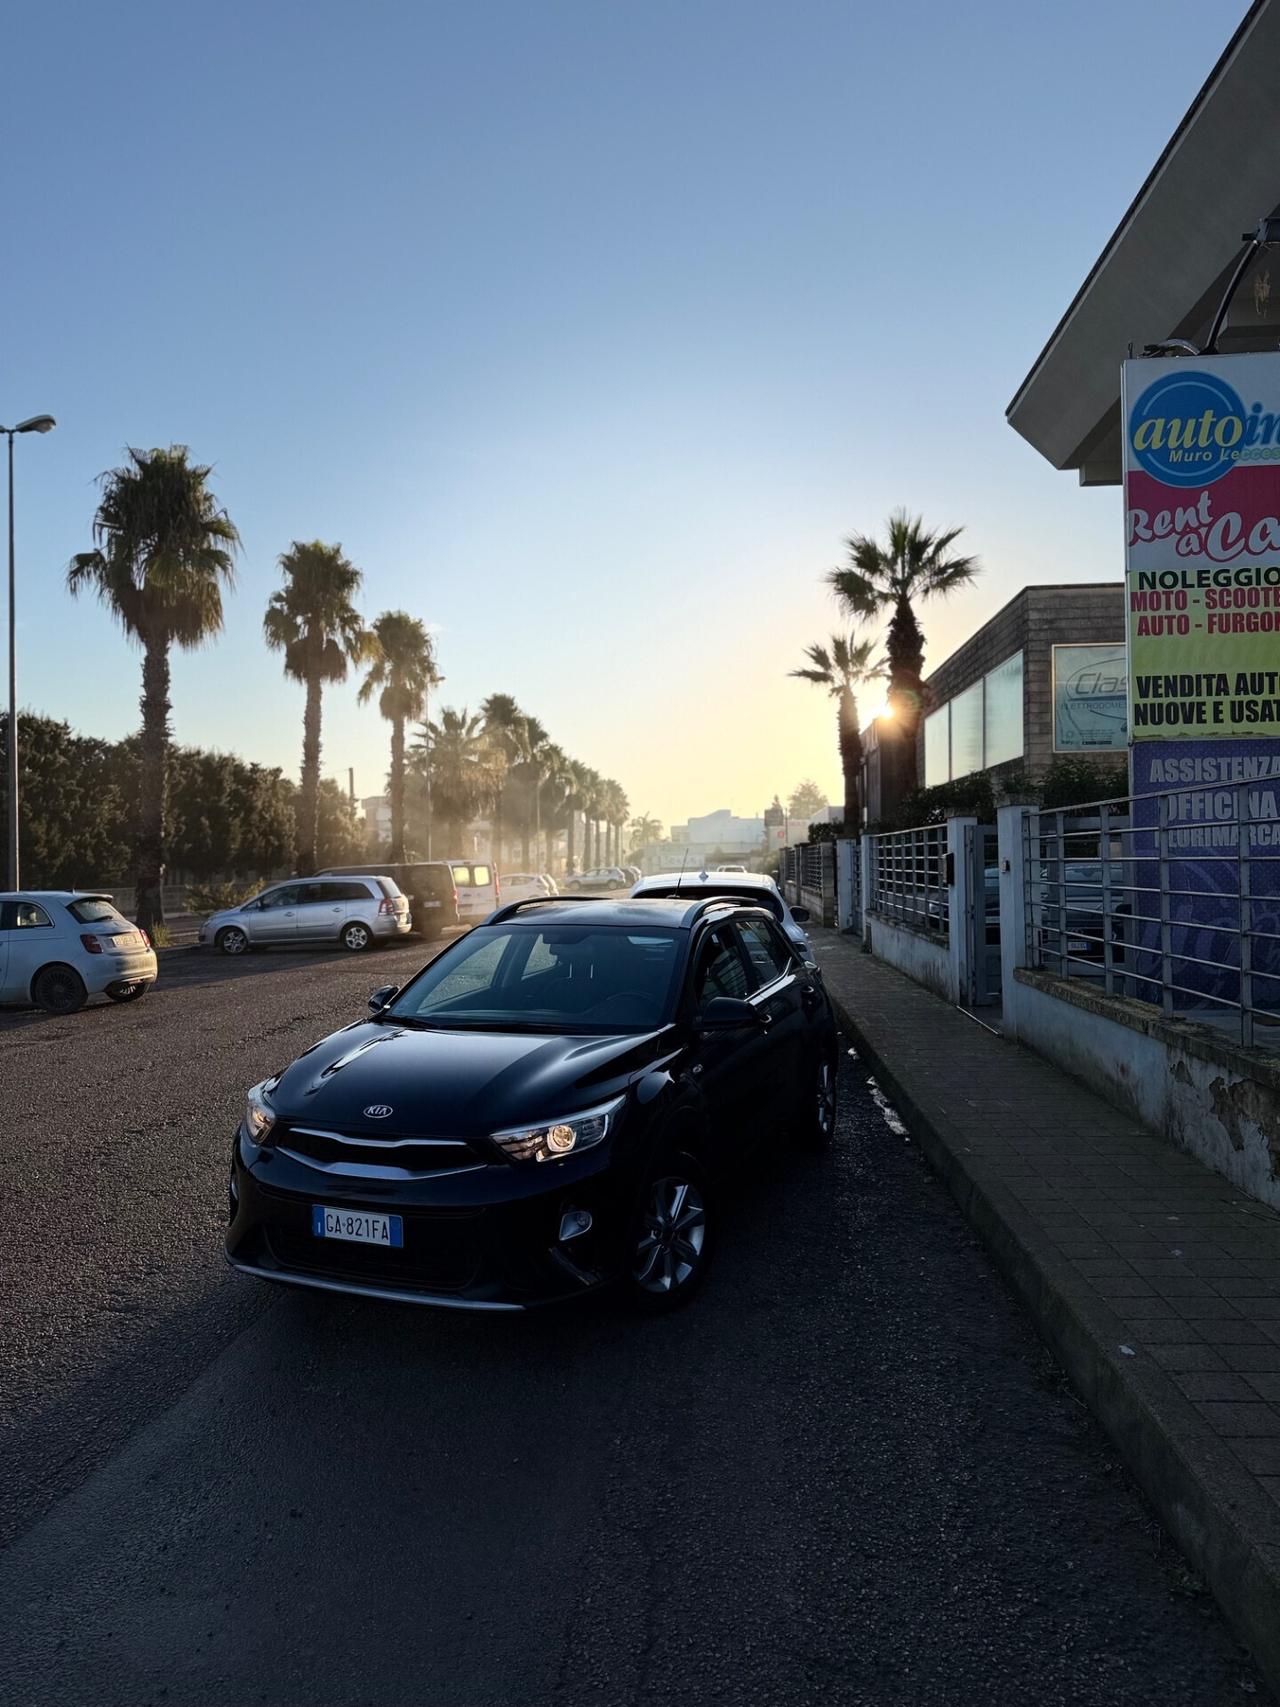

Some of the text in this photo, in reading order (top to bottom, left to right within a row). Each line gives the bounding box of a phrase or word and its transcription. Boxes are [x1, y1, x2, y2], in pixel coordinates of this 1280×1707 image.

[1168, 450, 1212, 463] Muro
[1128, 490, 1213, 542] Rent
[1177, 532, 1201, 556] a
[1138, 567, 1280, 590] NOLEGGIO
[1130, 589, 1188, 612] MOTO
[1137, 614, 1190, 636] AUTO
[1136, 672, 1280, 699] VENDITA AUT
[1134, 702, 1207, 726] NUOVE
[1213, 701, 1225, 724] E
[1150, 756, 1280, 783] ASSISTENZA
[367, 1105, 388, 1116] KIA
